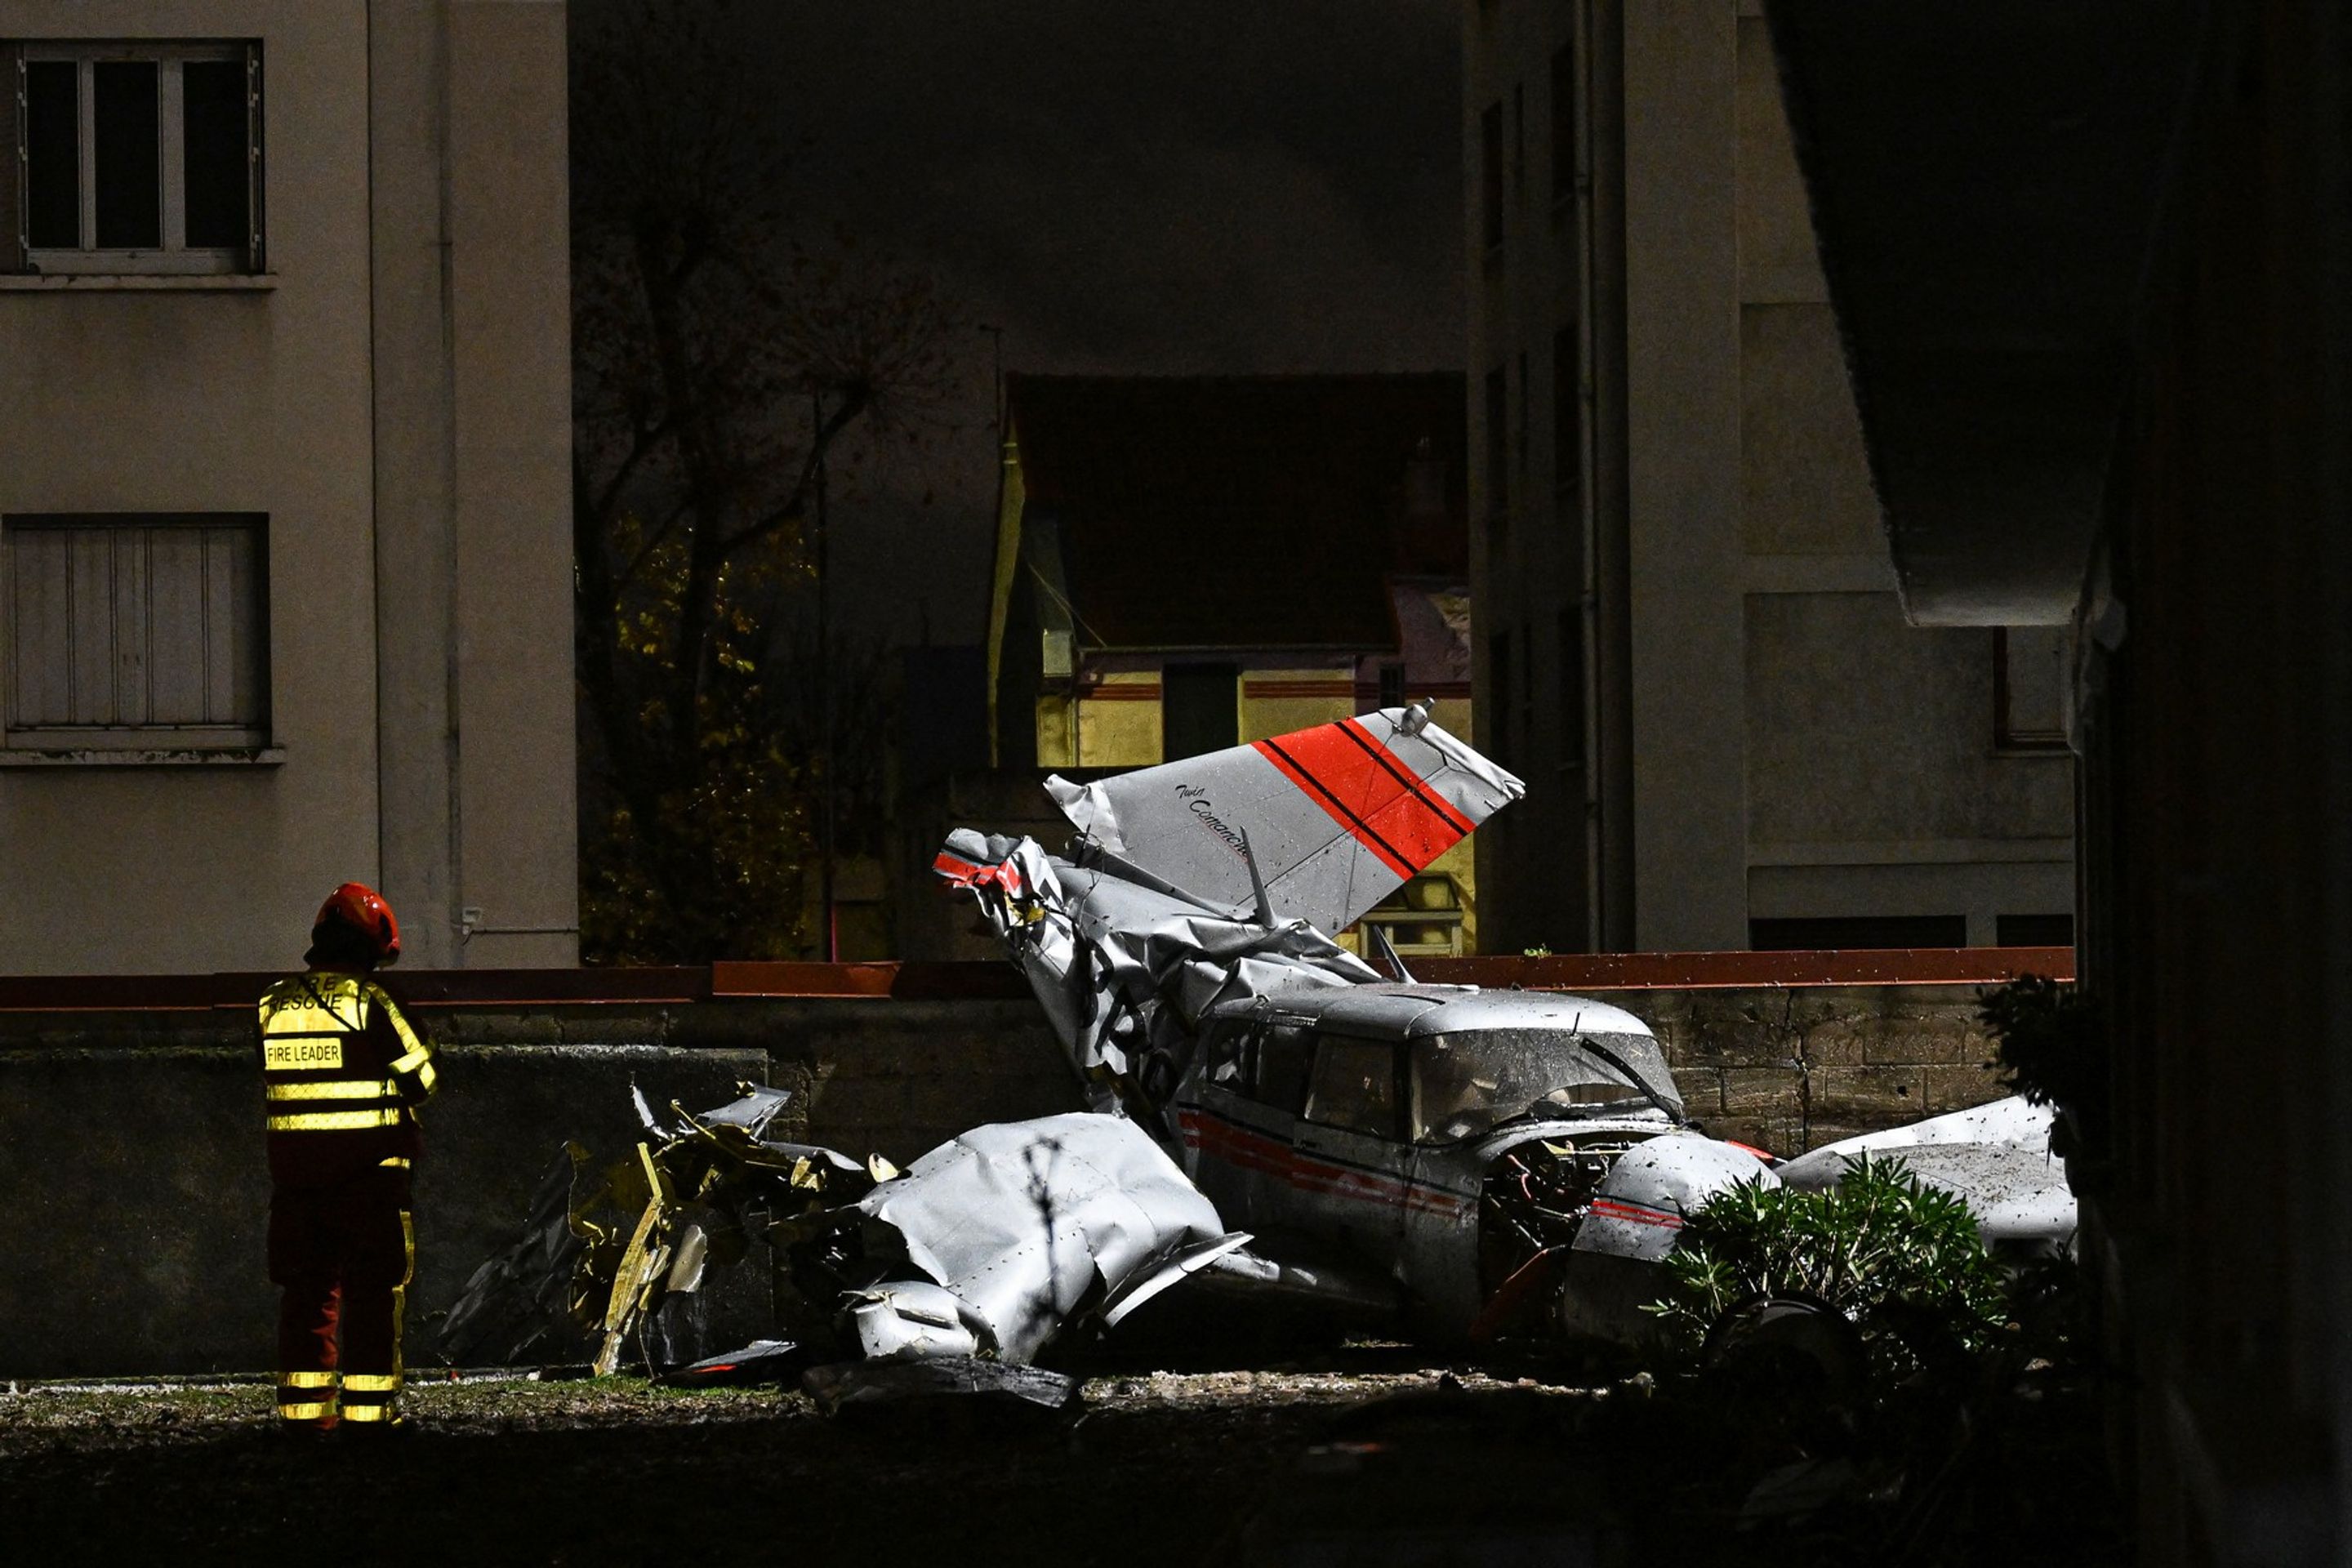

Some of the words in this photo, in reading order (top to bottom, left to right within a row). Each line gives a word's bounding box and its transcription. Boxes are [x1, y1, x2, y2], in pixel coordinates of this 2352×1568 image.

[1174, 785, 1205, 799] Twin
[268, 1047, 291, 1062] FIRE
[294, 1045, 340, 1062] LEADER
